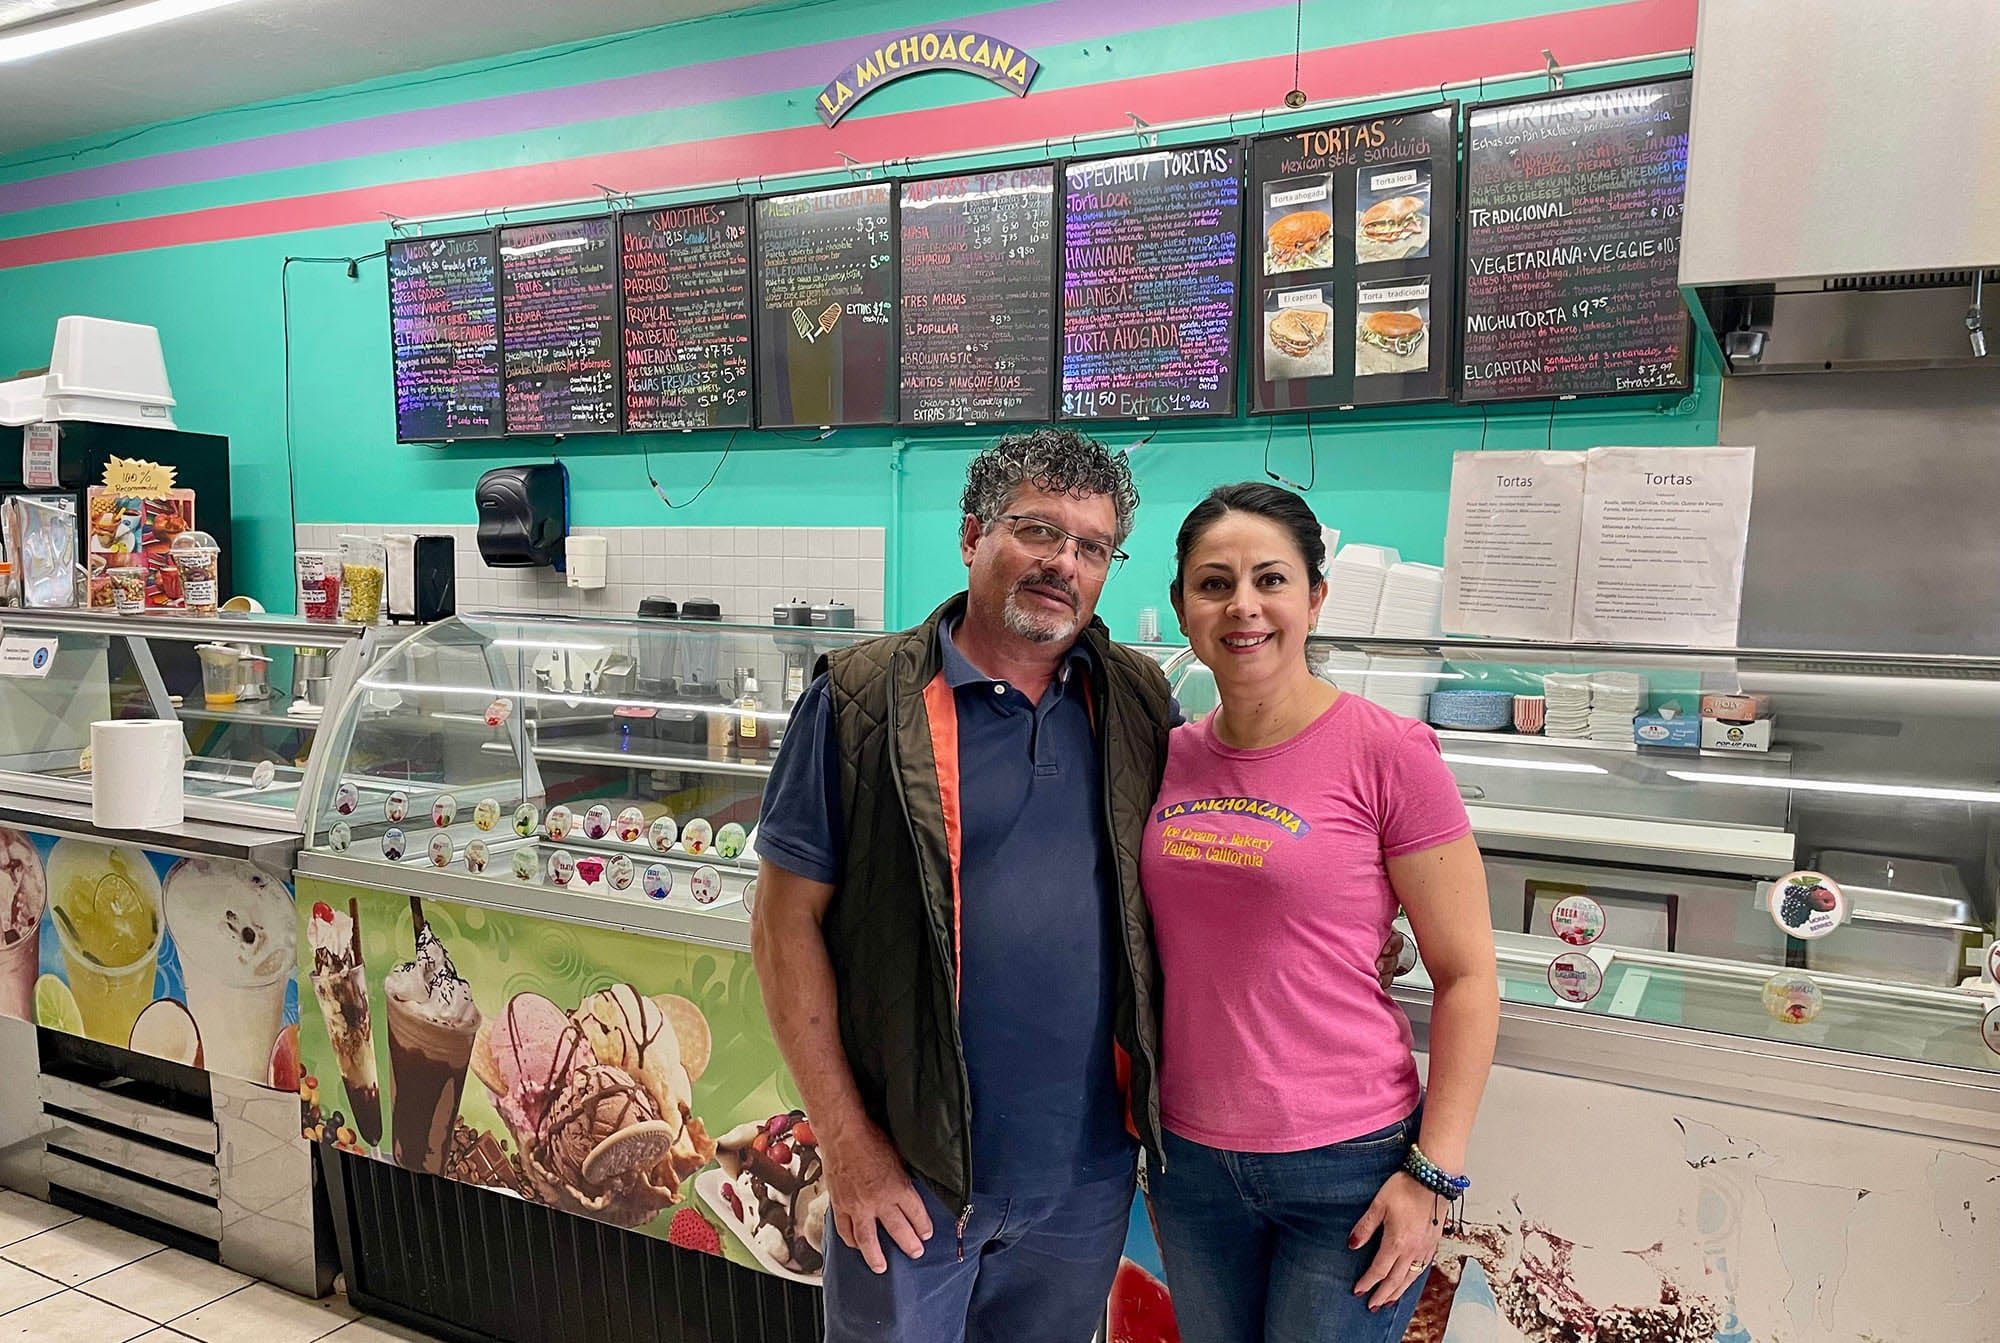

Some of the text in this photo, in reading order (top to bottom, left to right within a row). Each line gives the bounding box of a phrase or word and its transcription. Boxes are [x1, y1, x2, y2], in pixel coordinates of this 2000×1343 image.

[820, 33, 1028, 115] LA MICHOACANA
[1072, 148, 1229, 190] SPECIALTY TORTAS
[1281, 157, 1326, 174] Mexican
[1376, 177, 1396, 187] Torta
[1274, 190, 1325, 204] Torta ahogada
[652, 205, 720, 231] SMOOTHIES
[1469, 202, 1572, 228] TRADICIONAL
[1292, 293, 1318, 303] capitan
[1388, 288, 1427, 298] tradicional
[1467, 307, 1567, 333] MICHUTORTA
[1065, 331, 1109, 354] TORTA
[1113, 323, 1180, 351] AHOGADA
[1465, 364, 1483, 380] EL
[1485, 357, 1541, 379] CAPITAN
[1497, 475, 1533, 487] Tortas
[1644, 472, 1693, 485] Tortas
[1164, 798, 1303, 834] LA MICHOACANA
[1163, 824, 1180, 838] Ice
[1181, 828, 1217, 844] Cream
[1231, 833, 1273, 852] Bakery
[1205, 847, 1264, 868] California
[1809, 914, 1830, 924] MORAS
